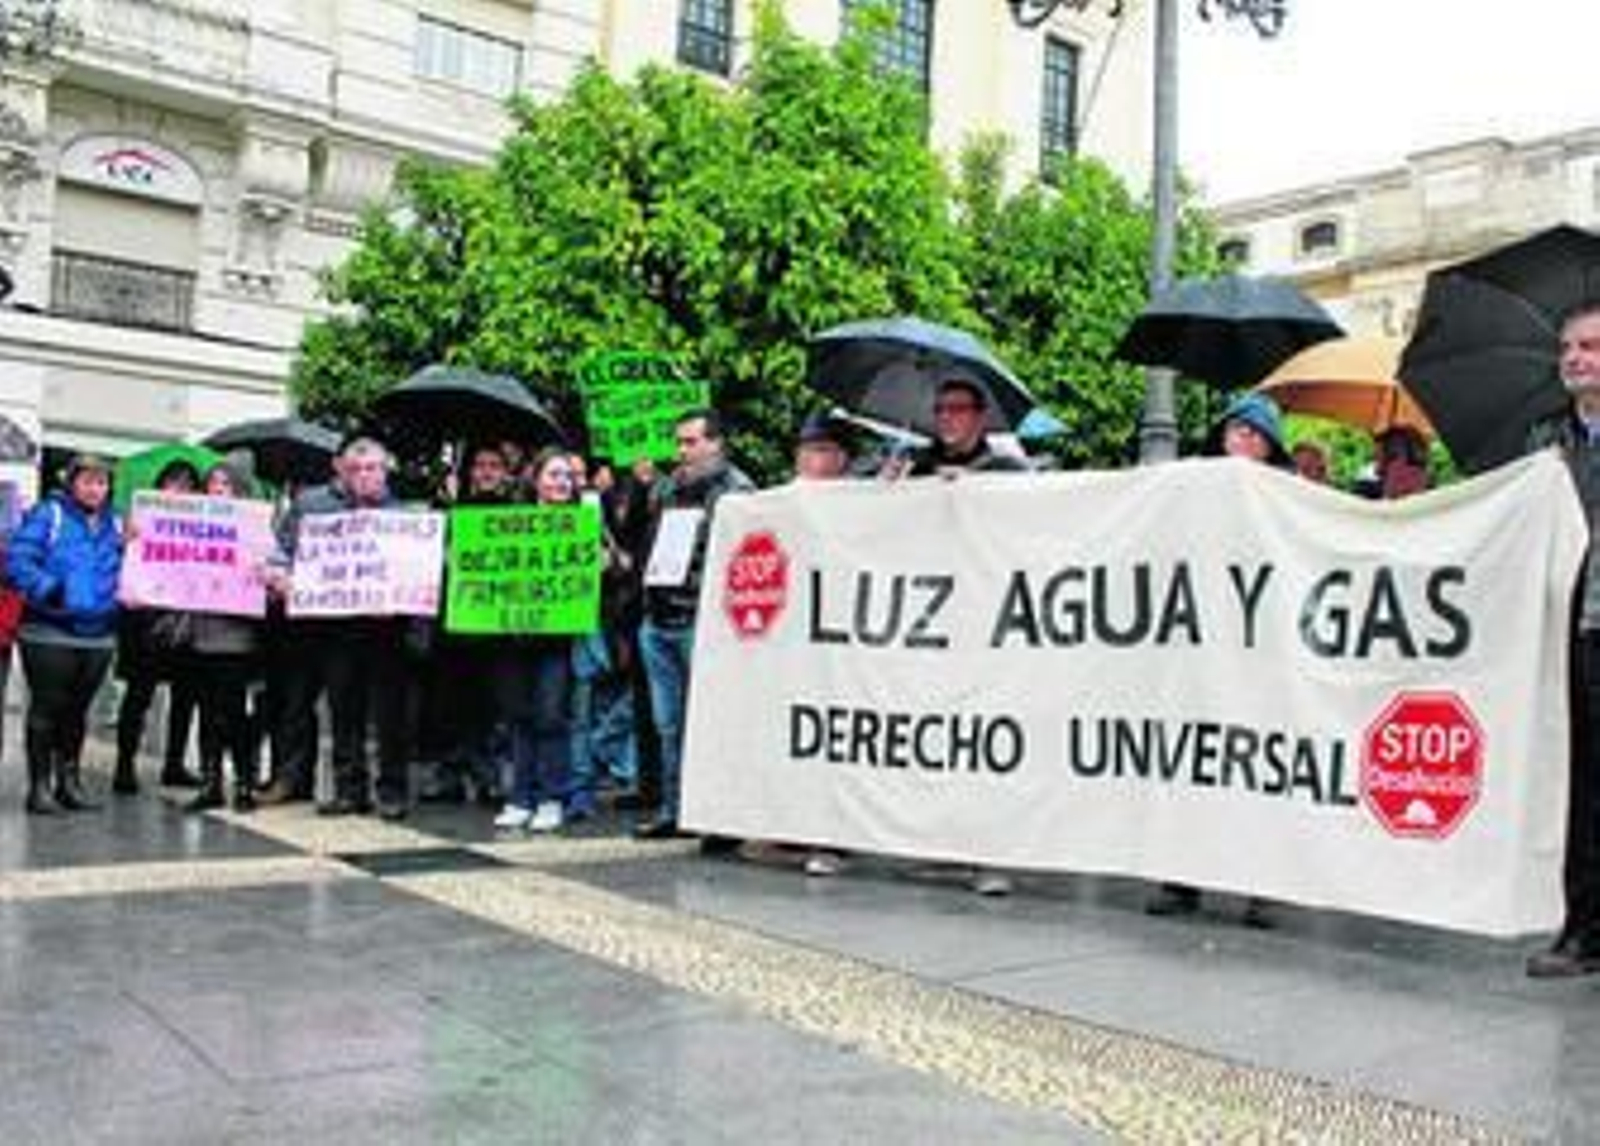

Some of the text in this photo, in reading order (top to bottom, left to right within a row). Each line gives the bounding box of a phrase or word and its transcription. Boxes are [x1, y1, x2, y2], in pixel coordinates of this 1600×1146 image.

[731, 554, 778, 588] STOP
[809, 562, 1471, 659] LUZ AGUA Y GAS
[789, 704, 1359, 807] DERECHO UNVERSAL
[1378, 723, 1472, 763] STOP
